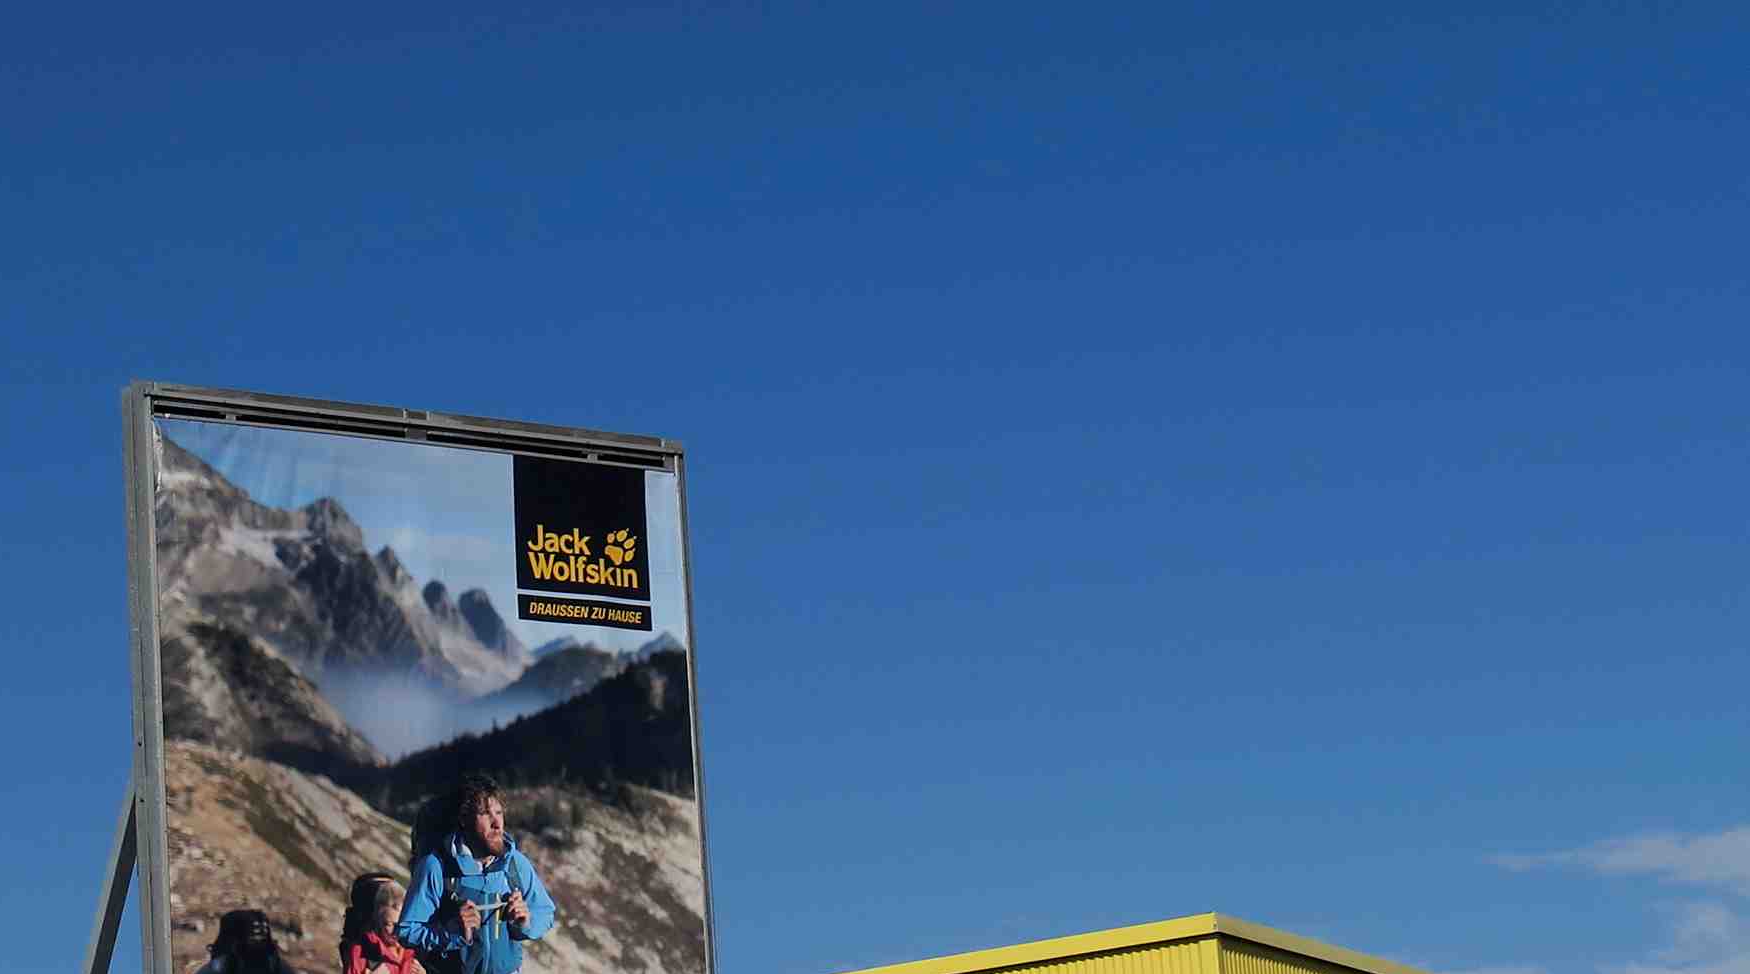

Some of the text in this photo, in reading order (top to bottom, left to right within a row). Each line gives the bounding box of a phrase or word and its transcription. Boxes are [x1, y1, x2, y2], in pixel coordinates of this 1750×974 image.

[527, 524, 592, 556] Jack
[527, 552, 638, 588] Wolfskin
[529, 601, 643, 624] DRAUSSEN ZU HAUSE
